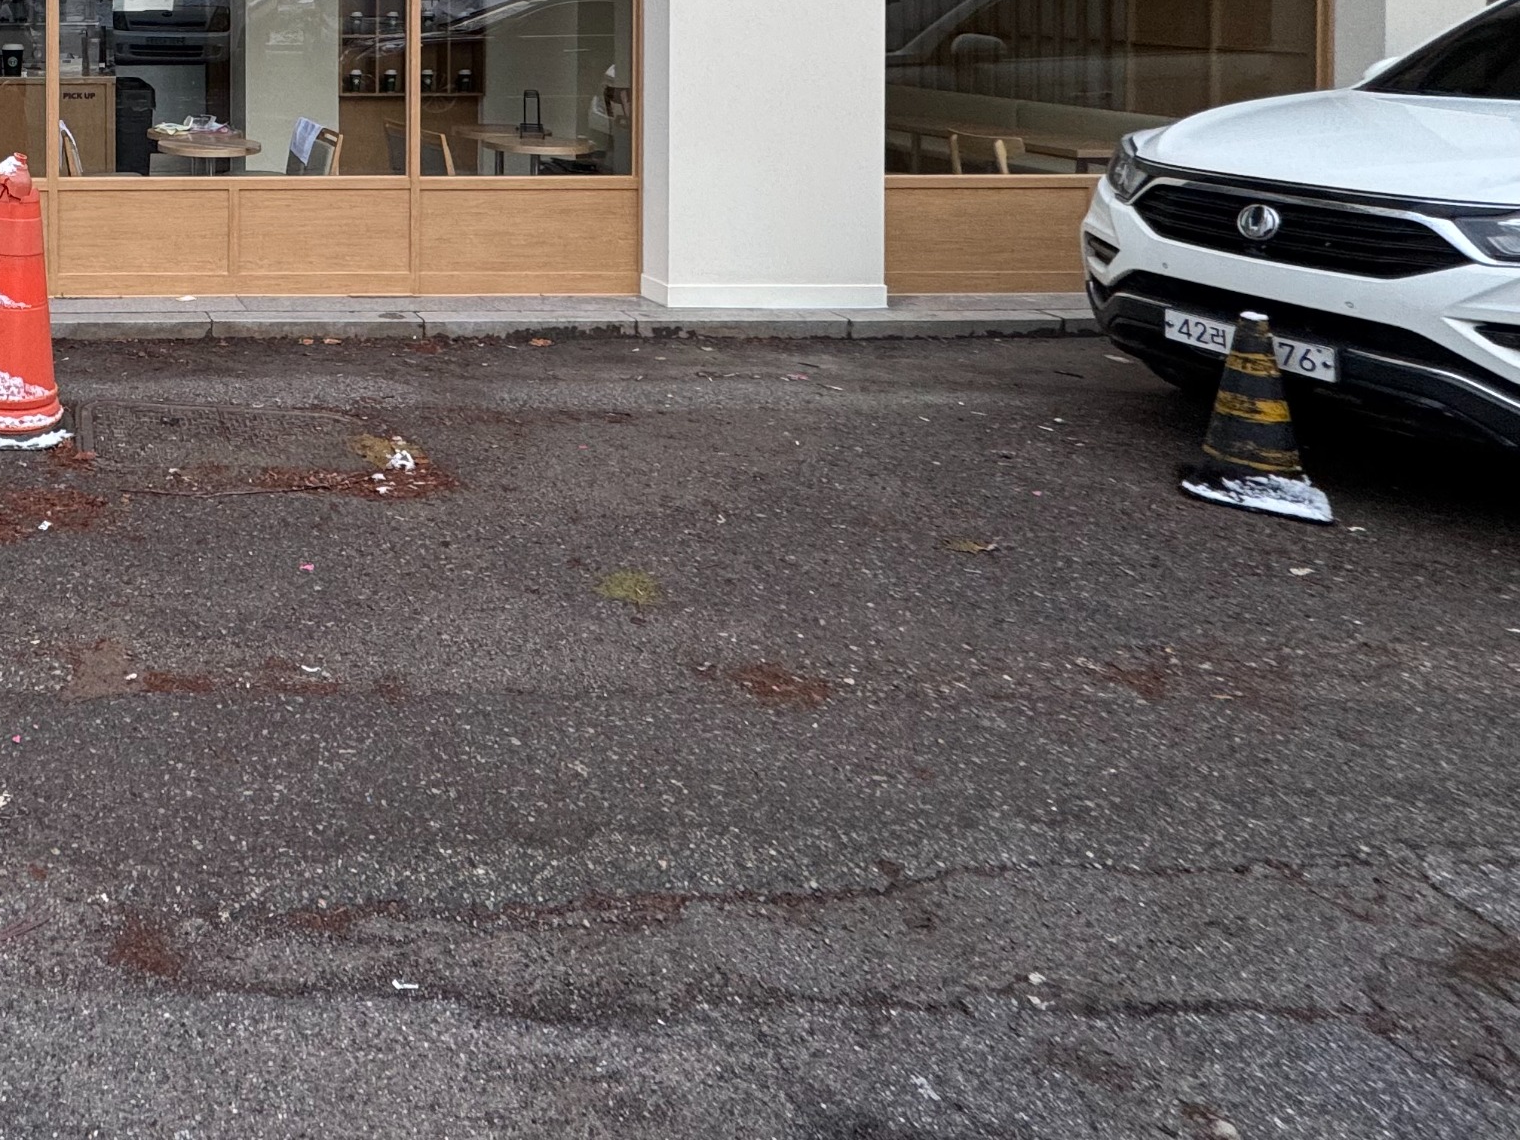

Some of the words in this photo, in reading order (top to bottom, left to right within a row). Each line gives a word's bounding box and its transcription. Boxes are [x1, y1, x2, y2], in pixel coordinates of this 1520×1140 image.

[63, 92, 83, 100] PICK
[84, 91, 96, 99] UP
[1177, 318, 1227, 349] 42러
[1277, 341, 1317, 373] 76
